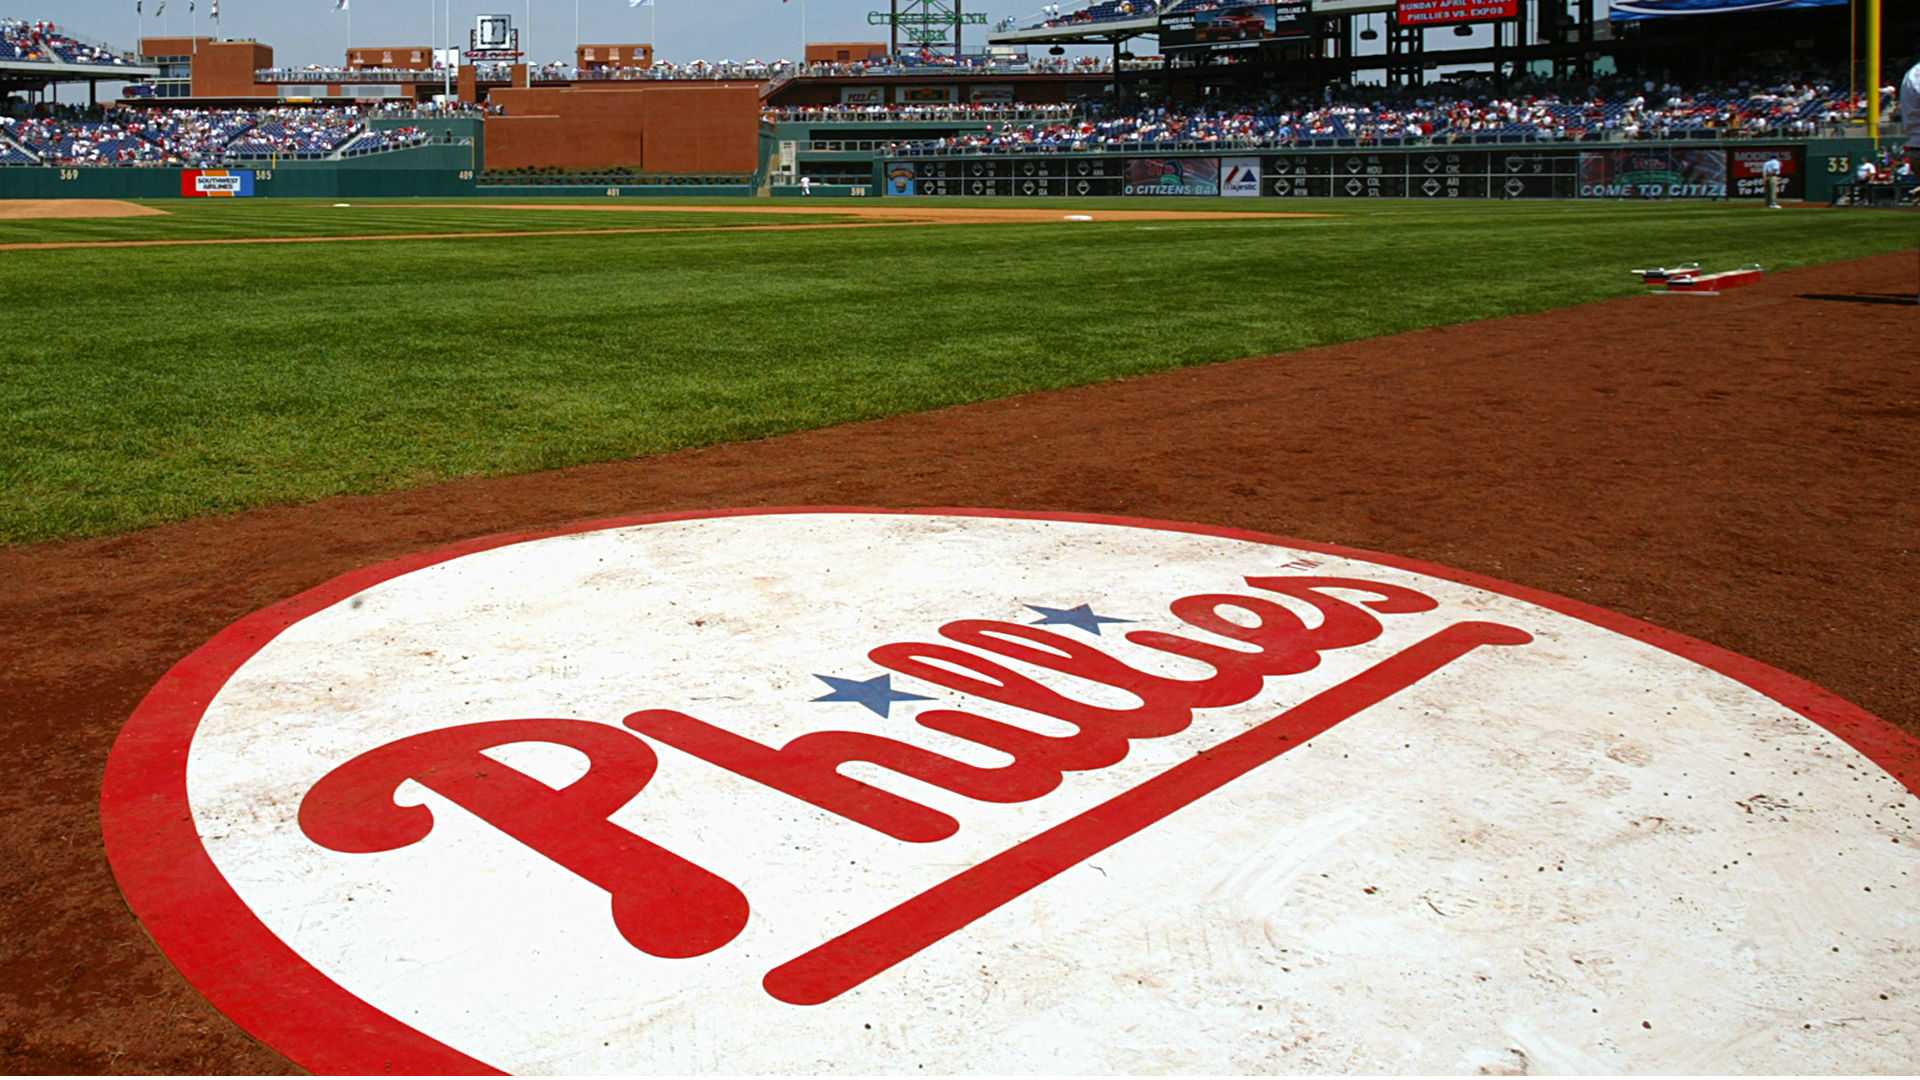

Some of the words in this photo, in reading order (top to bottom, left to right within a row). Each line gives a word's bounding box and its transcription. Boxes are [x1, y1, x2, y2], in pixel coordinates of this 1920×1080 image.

[1400, 1, 1437, 11] SUNDAY
[944, 10, 988, 24] BANK
[1408, 10, 1450, 20] PHILLIES
[1452, 9, 1468, 17] VS.
[1471, 6, 1504, 16] EXPOS
[909, 28, 947, 41] PARK
[1735, 152, 1792, 161] MODEL'S
[60, 169, 79, 180] 369
[606, 187, 620, 197] 401
[1136, 185, 1192, 195] CITIZENS
[1580, 184, 1633, 196] COME
[1637, 184, 1663, 196] TO
[298, 575, 1438, 959] Phillies
